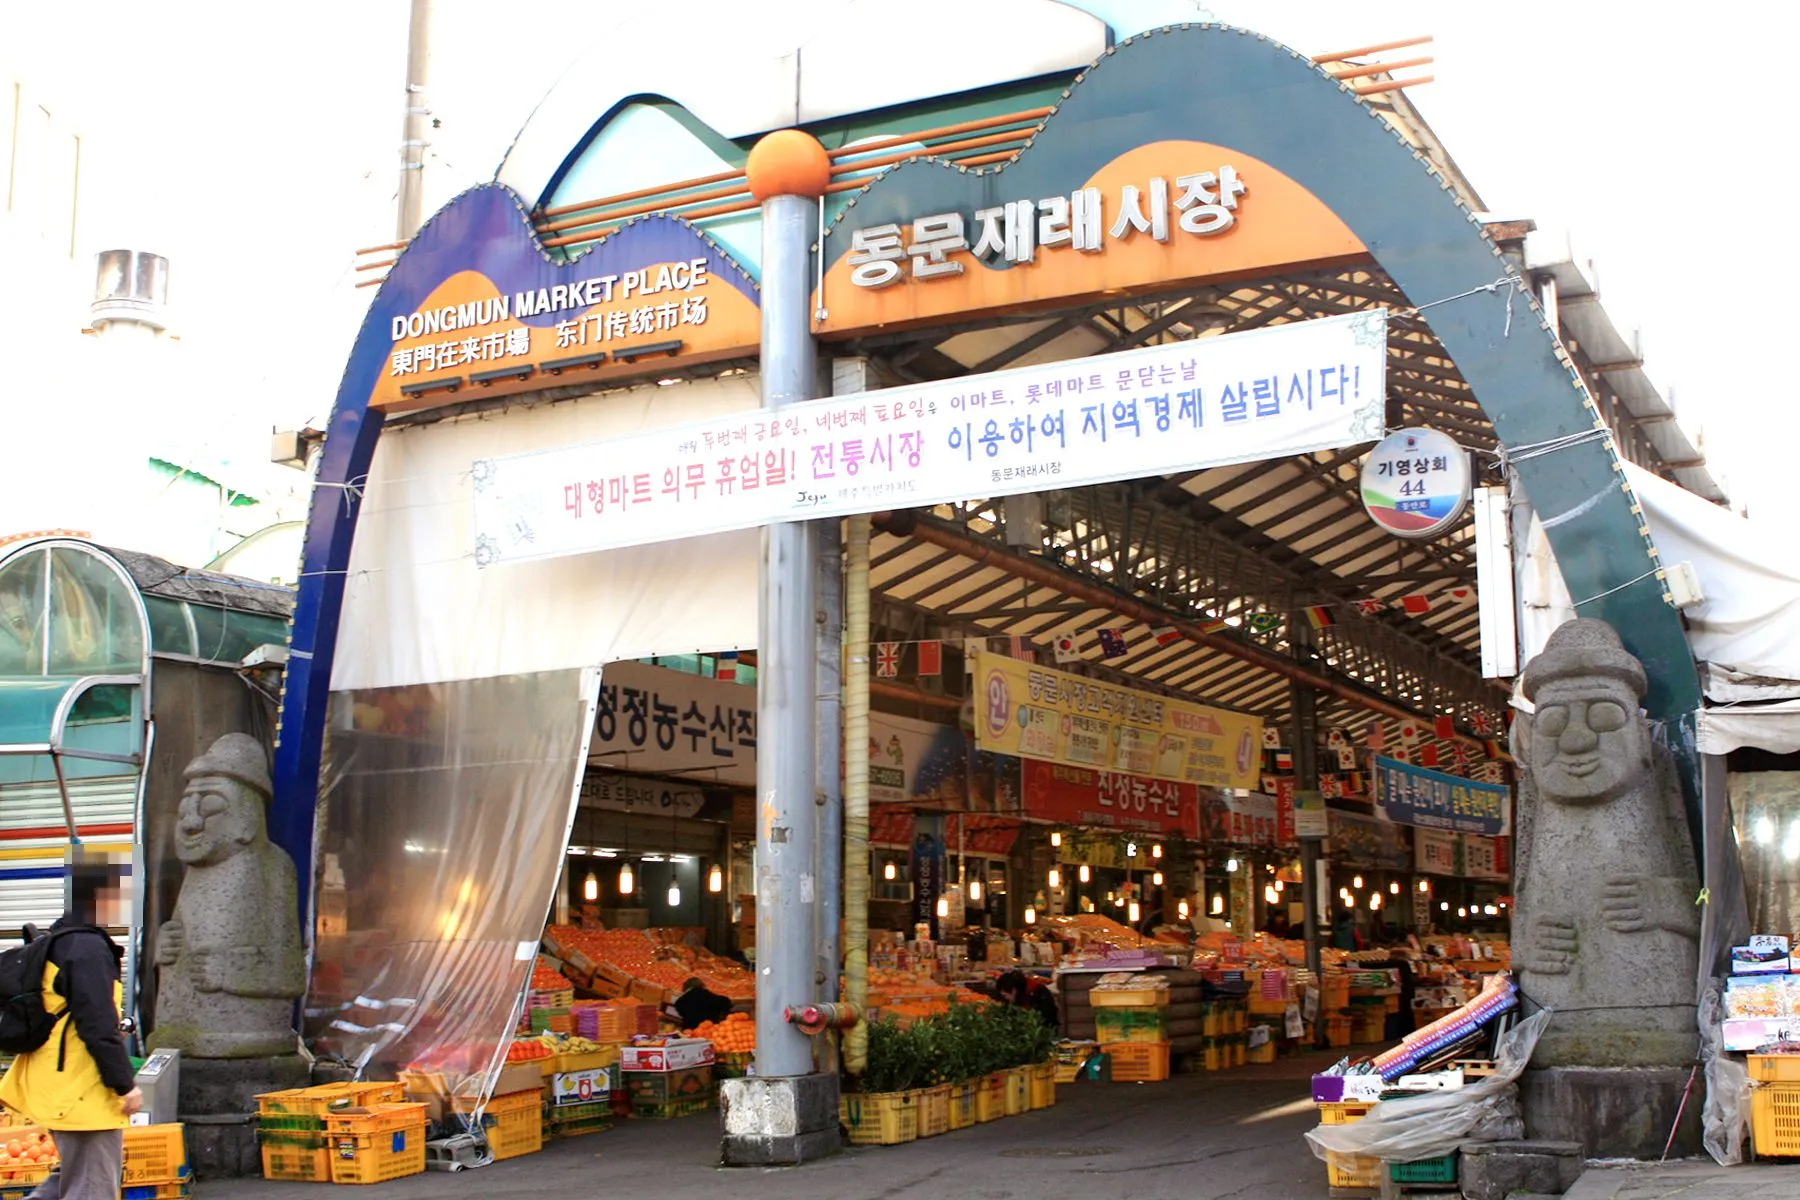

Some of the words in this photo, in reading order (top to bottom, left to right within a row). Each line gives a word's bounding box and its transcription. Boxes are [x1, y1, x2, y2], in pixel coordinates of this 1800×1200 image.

[847, 165, 1247, 288] 동문재래시장
[390, 329, 529, 377] 東門在来市場
[555, 297, 708, 349] 东门传统市场
[391, 296, 509, 341] DONGMUN
[515, 275, 618, 320] MARKET
[623, 258, 708, 299] PLACE
[564, 472, 652, 519] 대형마트
[662, 462, 706, 503] 의무
[715, 447, 796, 496] 휴업일!
[810, 430, 925, 480] 전통시장
[947, 414, 1067, 462] 이용하여
[1081, 389, 1205, 443] 지역경제
[1219, 364, 1363, 422] 살립시다!
[702, 425, 747, 450] 두번째
[753, 416, 808, 441] 금요일,
[816, 406, 866, 431] 네번째
[950, 381, 1015, 412] 이마트,
[1024, 373, 1106, 407] 롯데마트
[1116, 357, 1198, 390] 문닫는날
[990, 461, 1062, 483] 동문재래시장
[1378, 456, 1447, 476] 기영상회
[1399, 479, 1426, 496] 44
